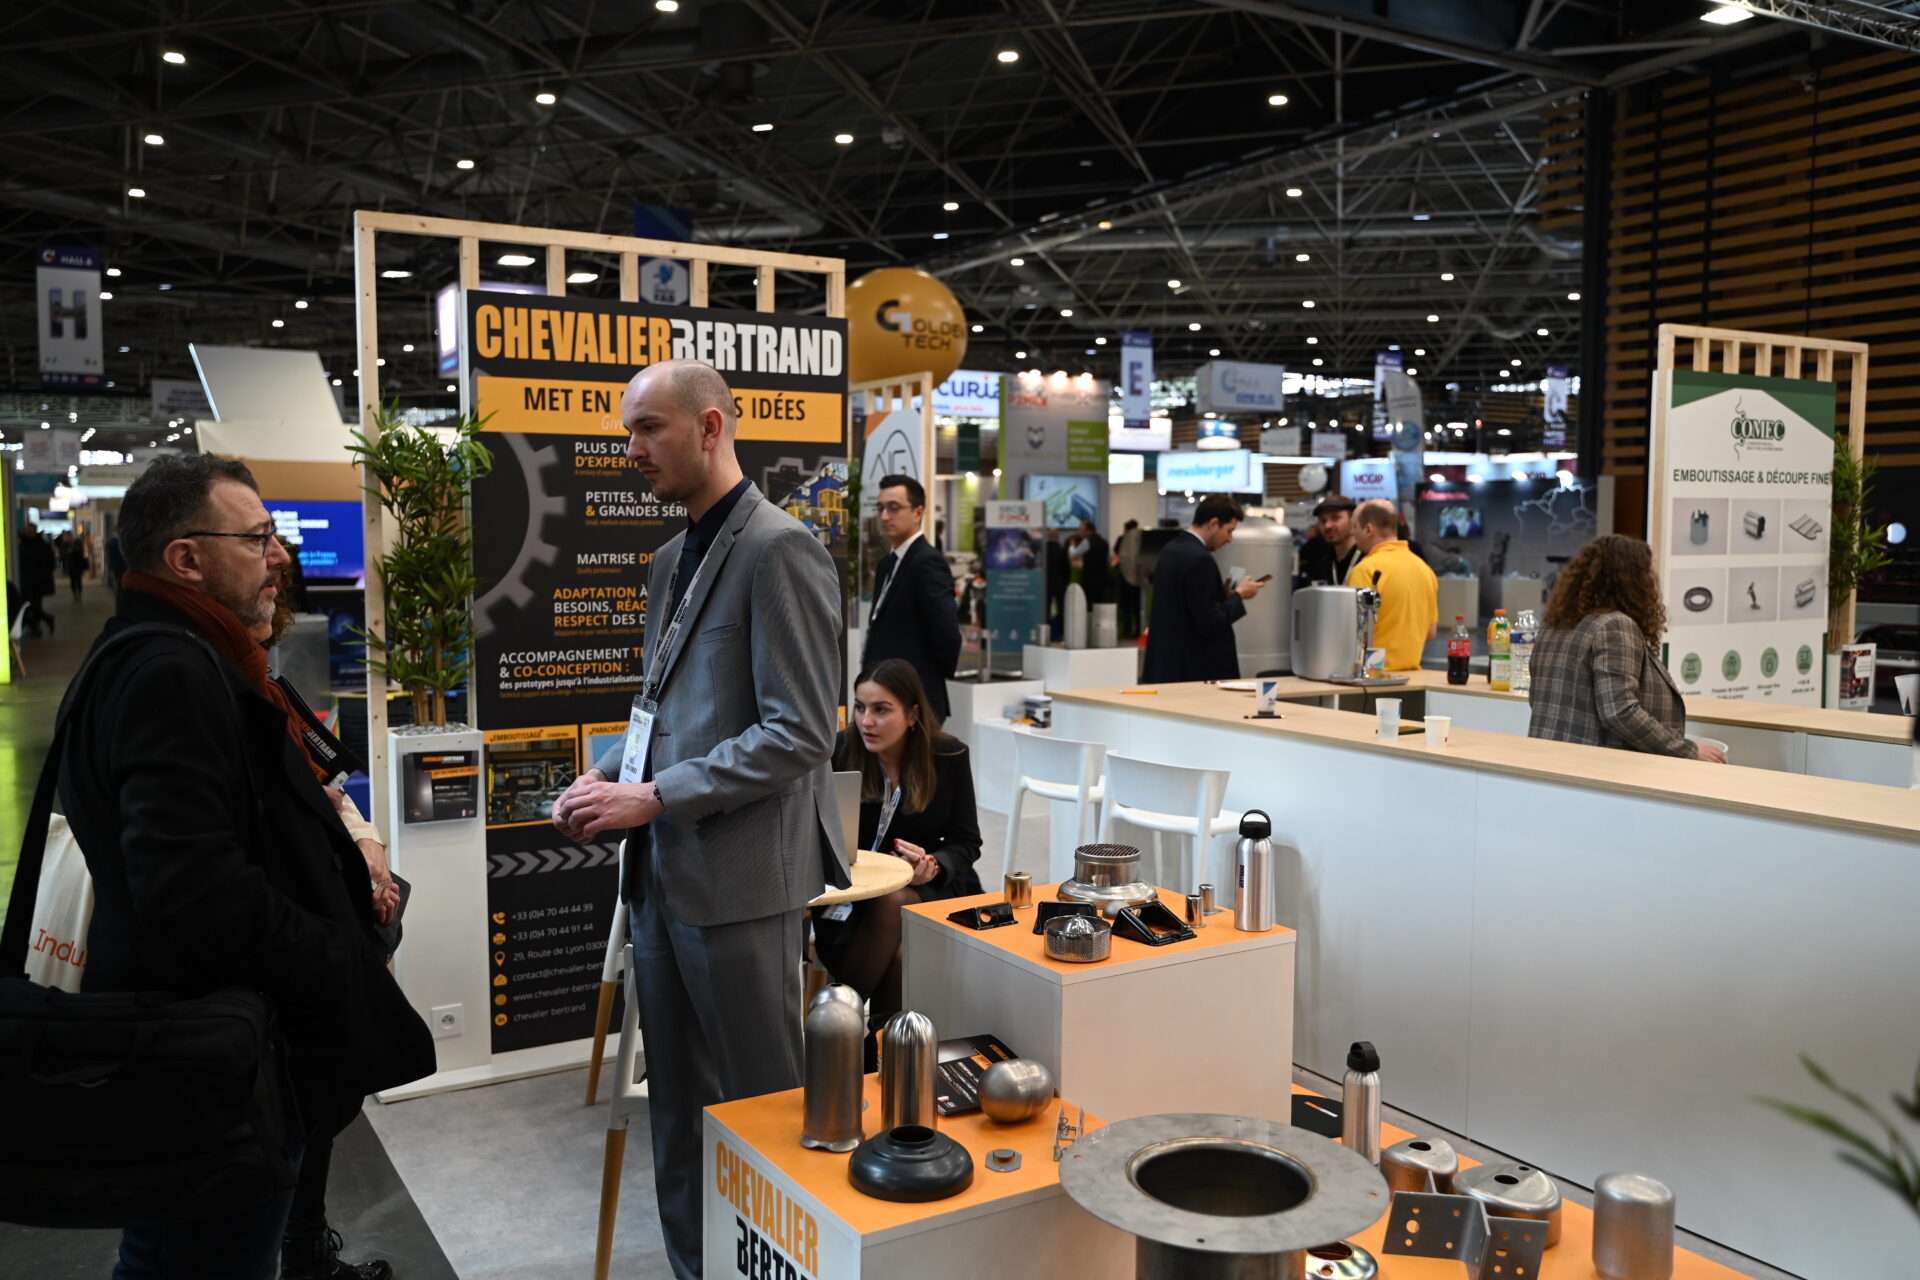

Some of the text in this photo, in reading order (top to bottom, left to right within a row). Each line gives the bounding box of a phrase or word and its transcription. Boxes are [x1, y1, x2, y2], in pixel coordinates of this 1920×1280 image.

[49, 288, 87, 340] H
[902, 334, 951, 350] TECH
[524, 386, 611, 413] MET EN
[752, 392, 806, 421] IDÉES
[575, 442, 607, 454] PLUS
[1673, 469, 1754, 483] EMBOUTISSAGE
[1757, 471, 1764, 483] &
[1766, 468, 1809, 484] DÉCOUPE
[585, 491, 638, 504] PETITES,
[585, 505, 596, 517] &
[599, 505, 659, 517] GRANDES
[577, 553, 635, 565] MAITRISE
[553, 587, 637, 599] ADAPTATION
[553, 601, 613, 614] BESOINS,
[554, 615, 609, 627] RESPECT
[612, 614, 636, 626] DES
[499, 648, 629, 664] ACCOMPAGNEMENT
[499, 666, 510, 678] &
[513, 662, 622, 678] CO-CONCEPTION
[499, 681, 513, 690] des
[514, 676, 555, 691] prototypes
[34, 928, 87, 968] Indu
[528, 949, 551, 960] Route
[552, 946, 564, 955] de
[565, 944, 585, 956] Lyon
[716, 1140, 818, 1279] CHEVALIER
